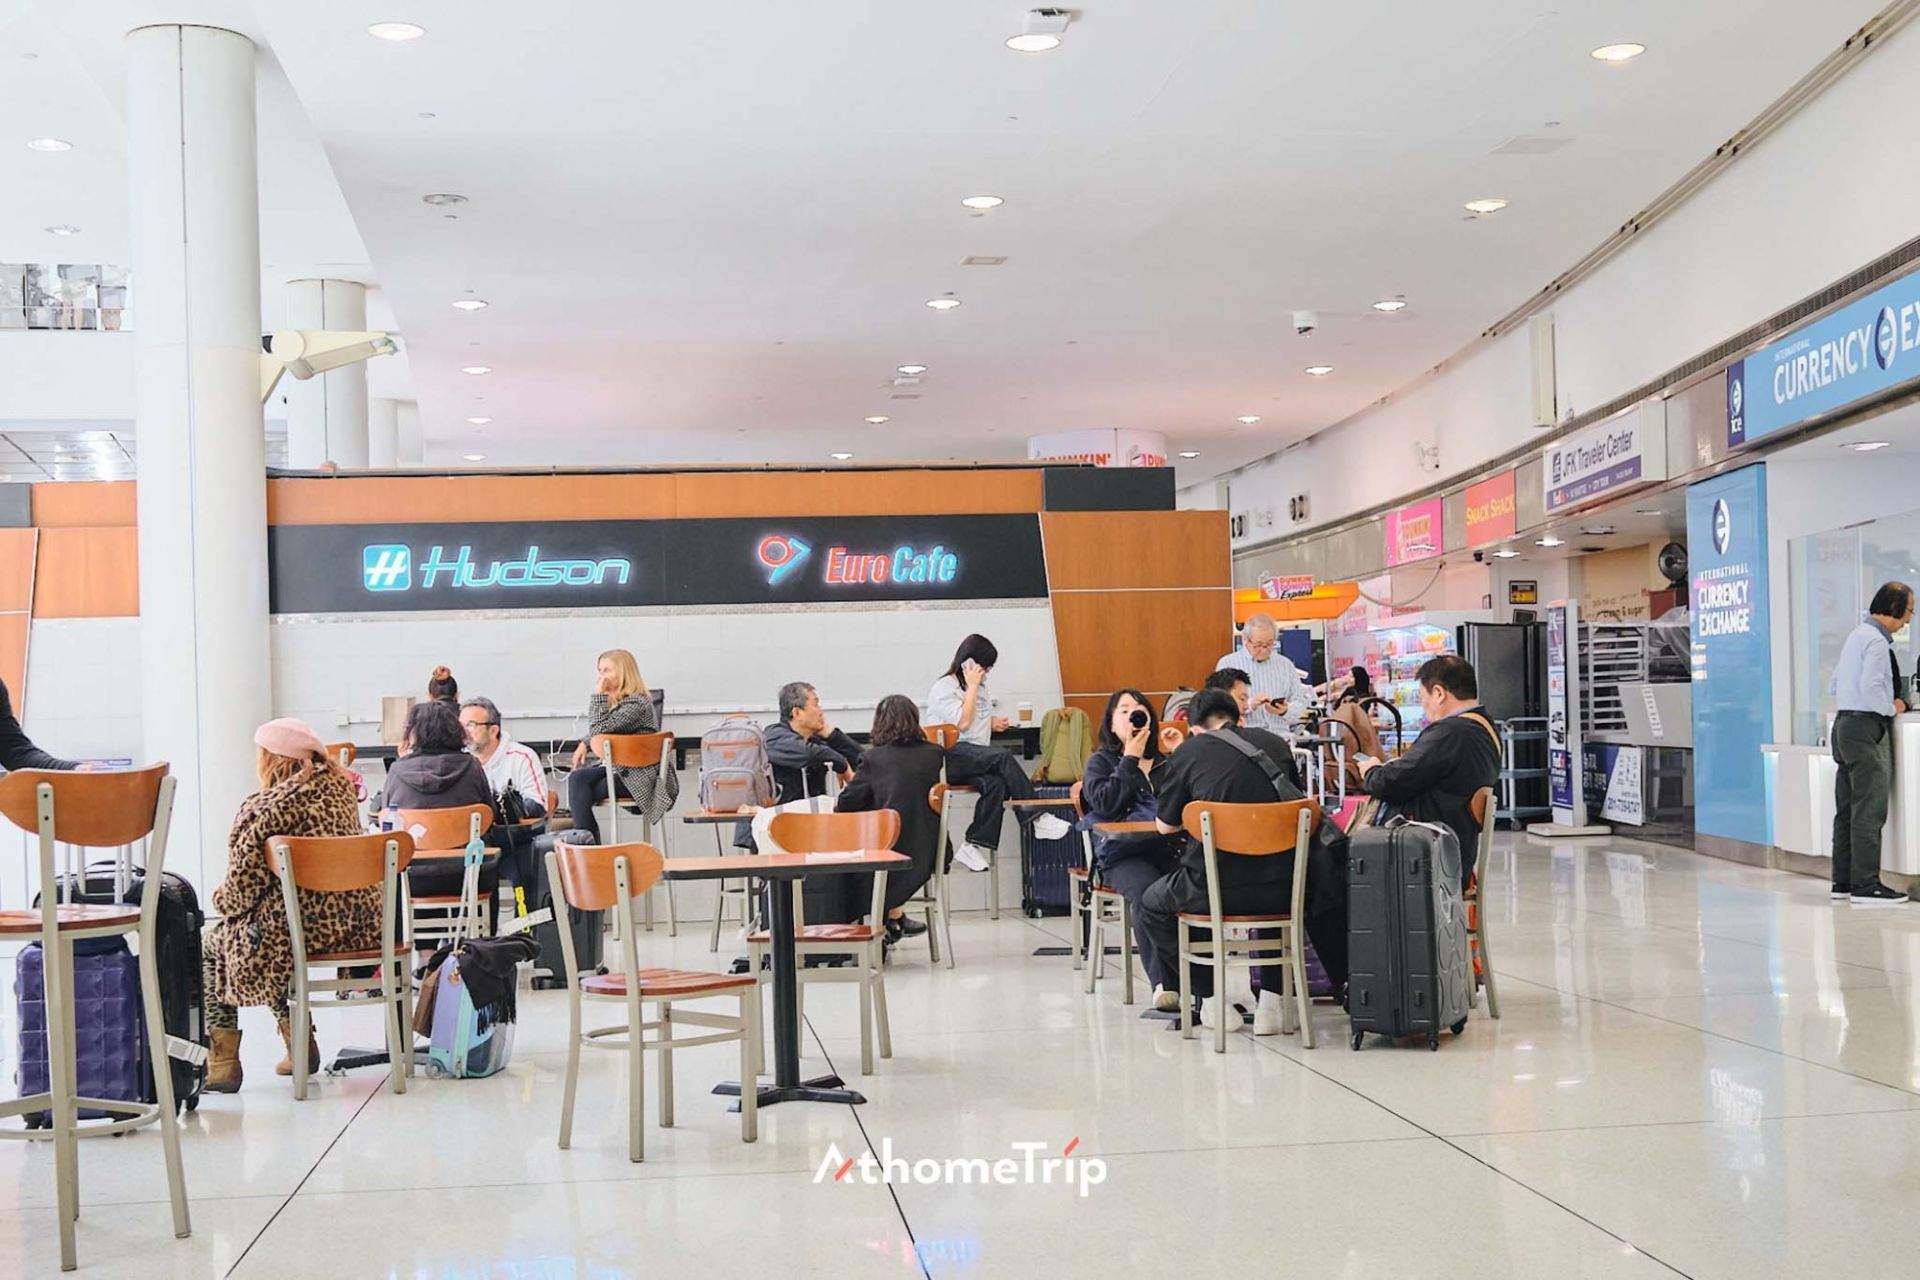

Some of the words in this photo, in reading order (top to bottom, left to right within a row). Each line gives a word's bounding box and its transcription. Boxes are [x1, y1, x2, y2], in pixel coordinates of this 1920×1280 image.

[1773, 323, 1872, 405] CURRENCY
[1730, 415, 1743, 435] ice
[1562, 450, 1577, 478] JFK
[1577, 440, 1606, 469] Traveler
[1607, 431, 1633, 458] Center
[1466, 503, 1490, 526] SNACK
[1491, 494, 1515, 517] SHACK
[419, 545, 631, 588] Hudson
[1697, 580, 1749, 610] CURRENCY
[1699, 608, 1751, 637] EXCHANGE
